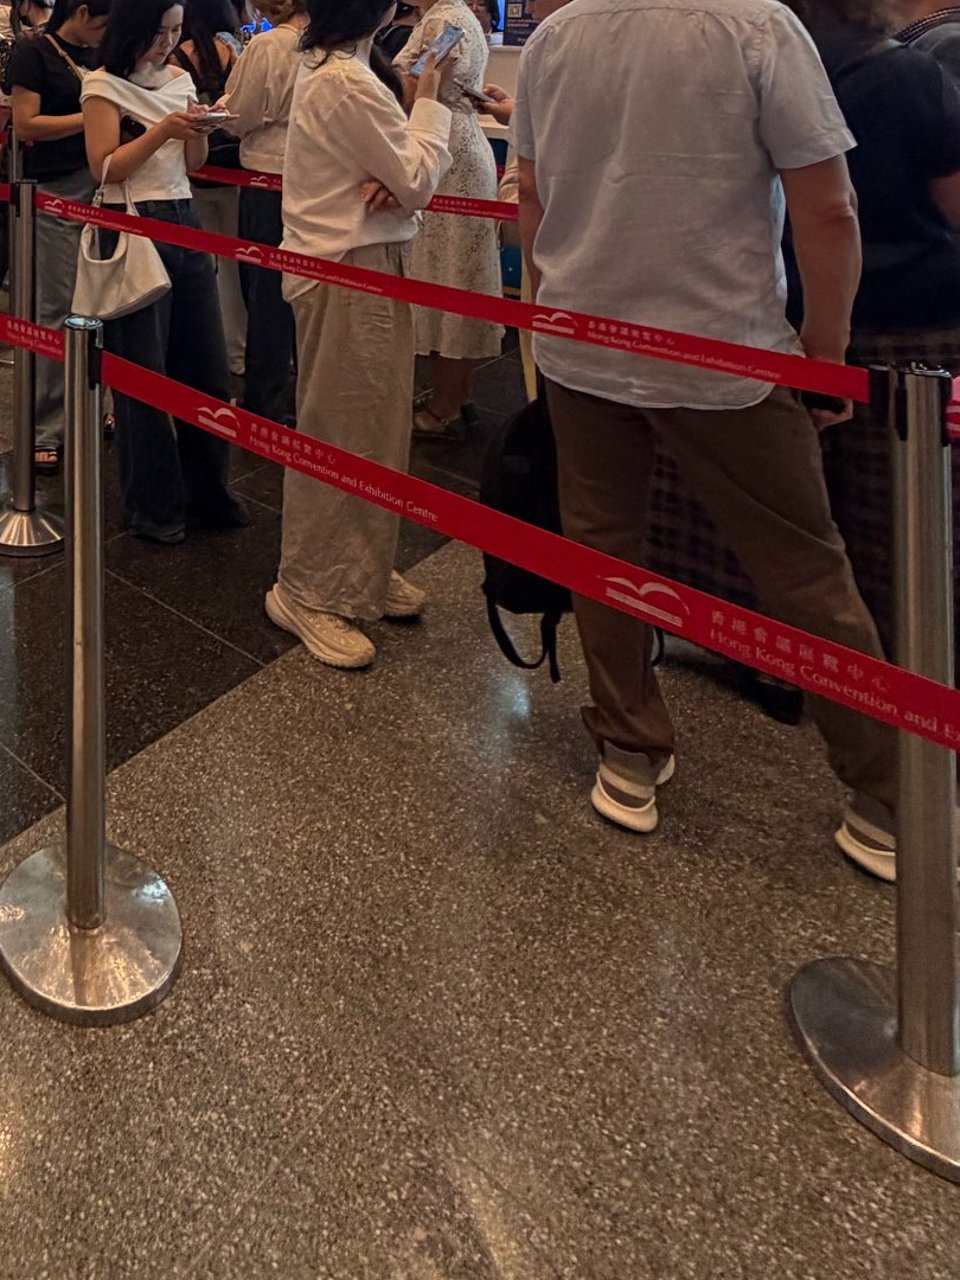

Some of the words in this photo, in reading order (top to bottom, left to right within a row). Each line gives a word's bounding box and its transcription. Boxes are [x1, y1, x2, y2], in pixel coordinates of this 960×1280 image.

[632, 340, 681, 357] Convention
[682, 350, 699, 362] and
[748, 364, 782, 379] Centre
[249, 434, 271, 453] Hong
[271, 443, 292, 462] Kong
[293, 452, 340, 480] Convention
[340, 473, 358, 489] and
[358, 479, 404, 507] Exhibition
[406, 500, 439, 522] Centre
[710, 628, 752, 660] Hong
[756, 646, 796, 678] Kong
[800, 665, 898, 716] Convention
[903, 709, 938, 733] and
